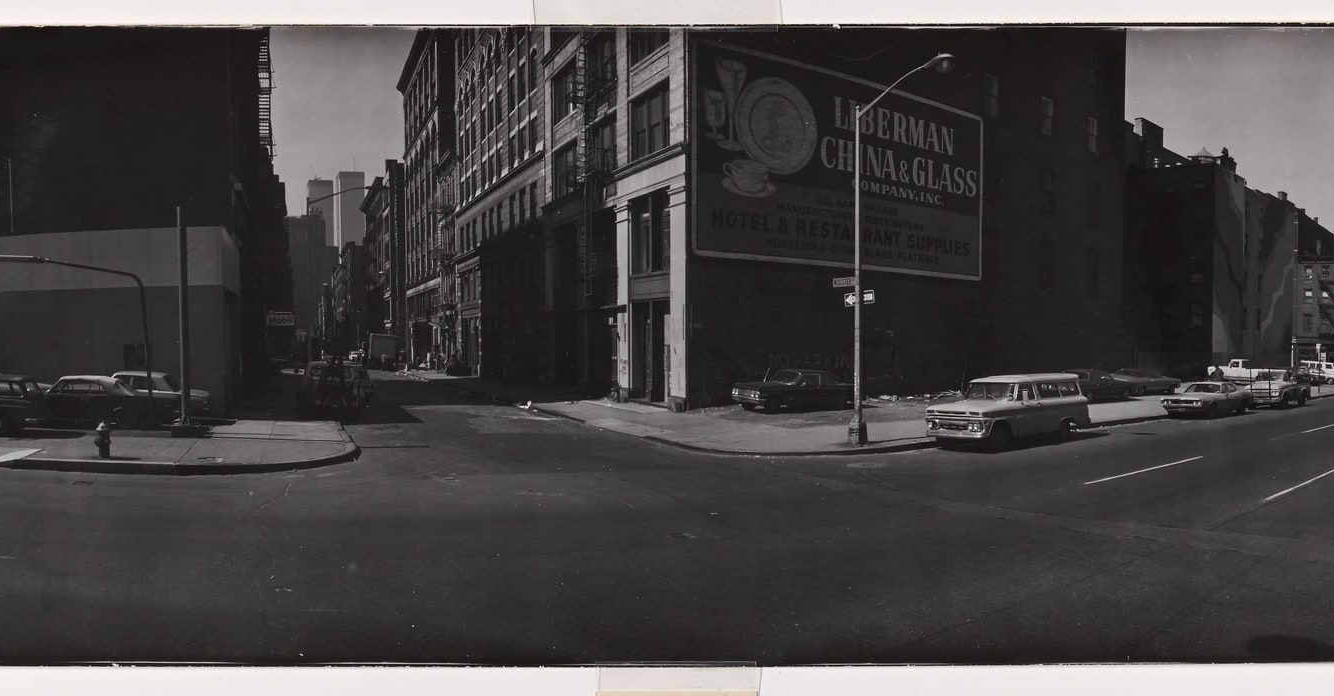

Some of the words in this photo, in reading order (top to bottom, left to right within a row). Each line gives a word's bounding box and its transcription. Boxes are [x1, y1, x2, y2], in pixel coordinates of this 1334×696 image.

[834, 96, 954, 156] LIBERMAN
[820, 136, 898, 182] CHINA
[899, 160, 910, 184] &
[912, 156, 978, 197] GLASS
[776, 202, 856, 222] MANUFACTURER
[864, 214, 924, 232] DISTRIBUTORS
[817, 195, 833, 207] ALL
[836, 199, 856, 210] NAM
[864, 203, 899, 216] BRANDS
[711, 207, 772, 233] HOTEL
[778, 216, 789, 235] &
[796, 219, 901, 247] RESTARANT
[907, 234, 970, 257] SUPPLIES
[765, 238, 827, 252] HOUSEHOLD
[830, 243, 856, 256] CHIN
[269, 316, 292, 325] Mobil
[769, 353, 789, 369] NO
[793, 352, 855, 369] PARKIN
